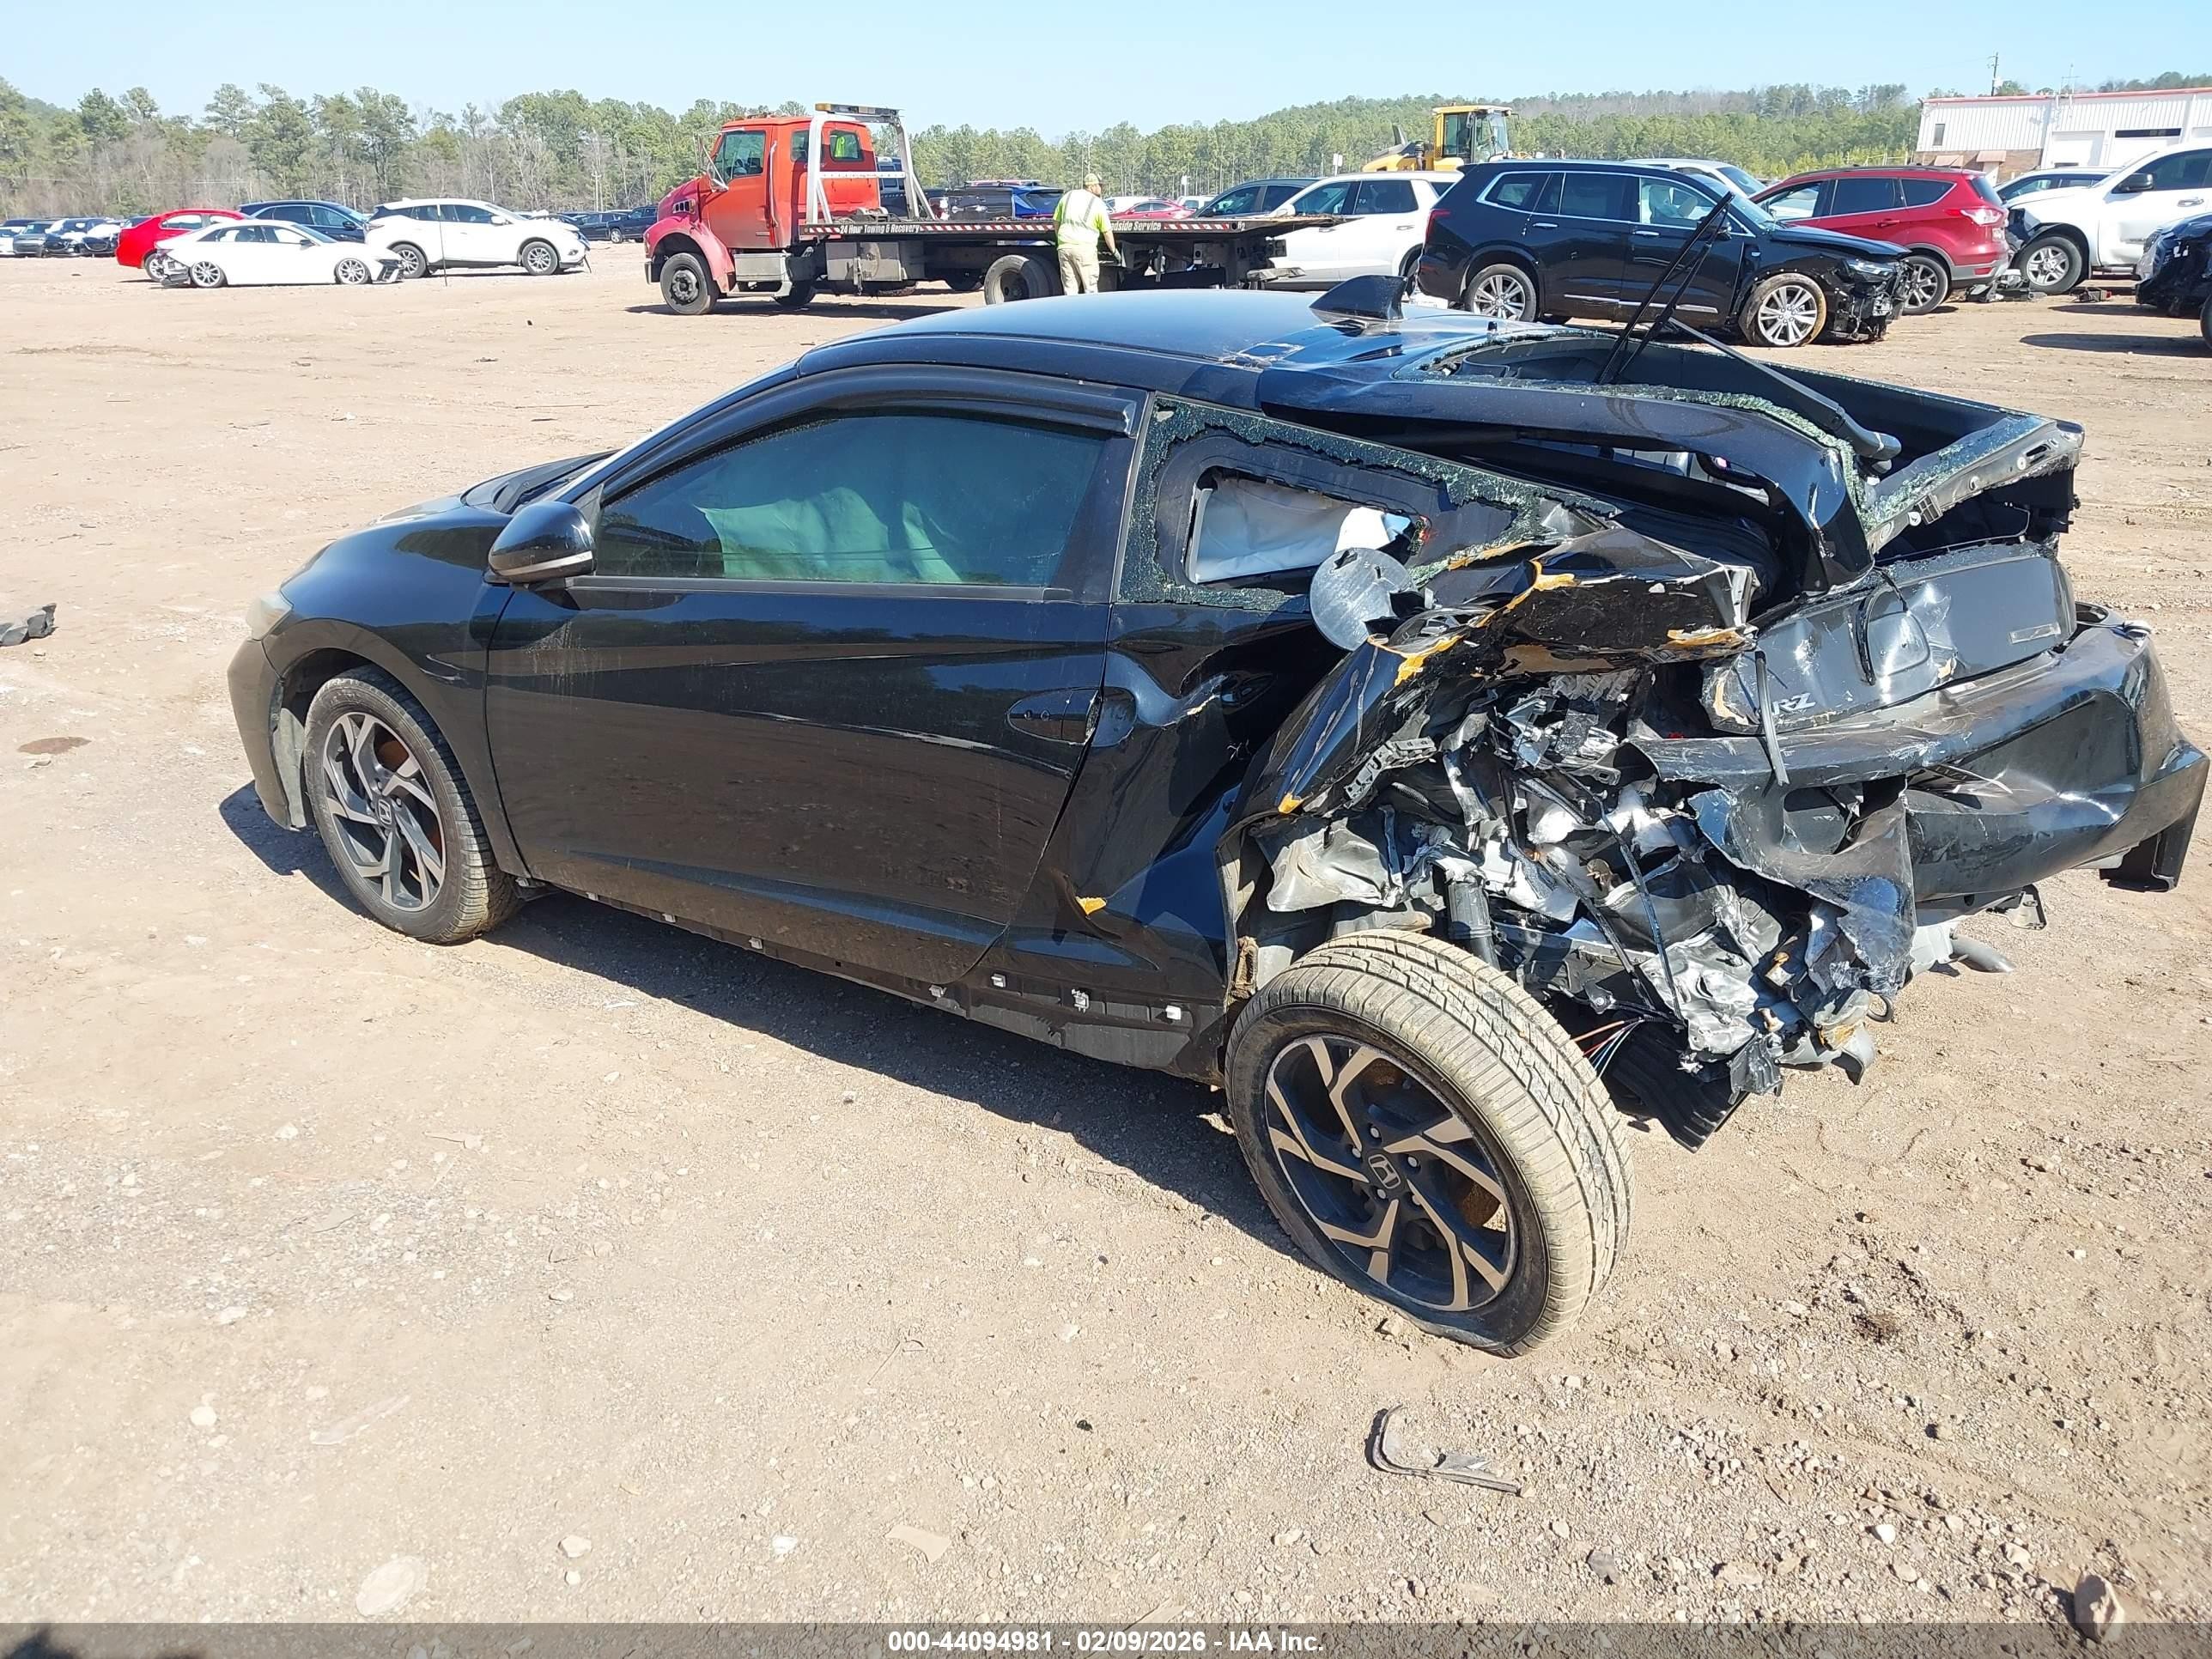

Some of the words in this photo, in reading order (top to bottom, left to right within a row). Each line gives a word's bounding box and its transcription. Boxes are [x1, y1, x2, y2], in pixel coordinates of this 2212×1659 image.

[840, 225, 848, 234] 24
[848, 225, 863, 234] Hour
[864, 224, 884, 234] Towing
[890, 223, 921, 234] Recovery
[1111, 220, 1133, 231] adside
[1133, 221, 1162, 231] Service
